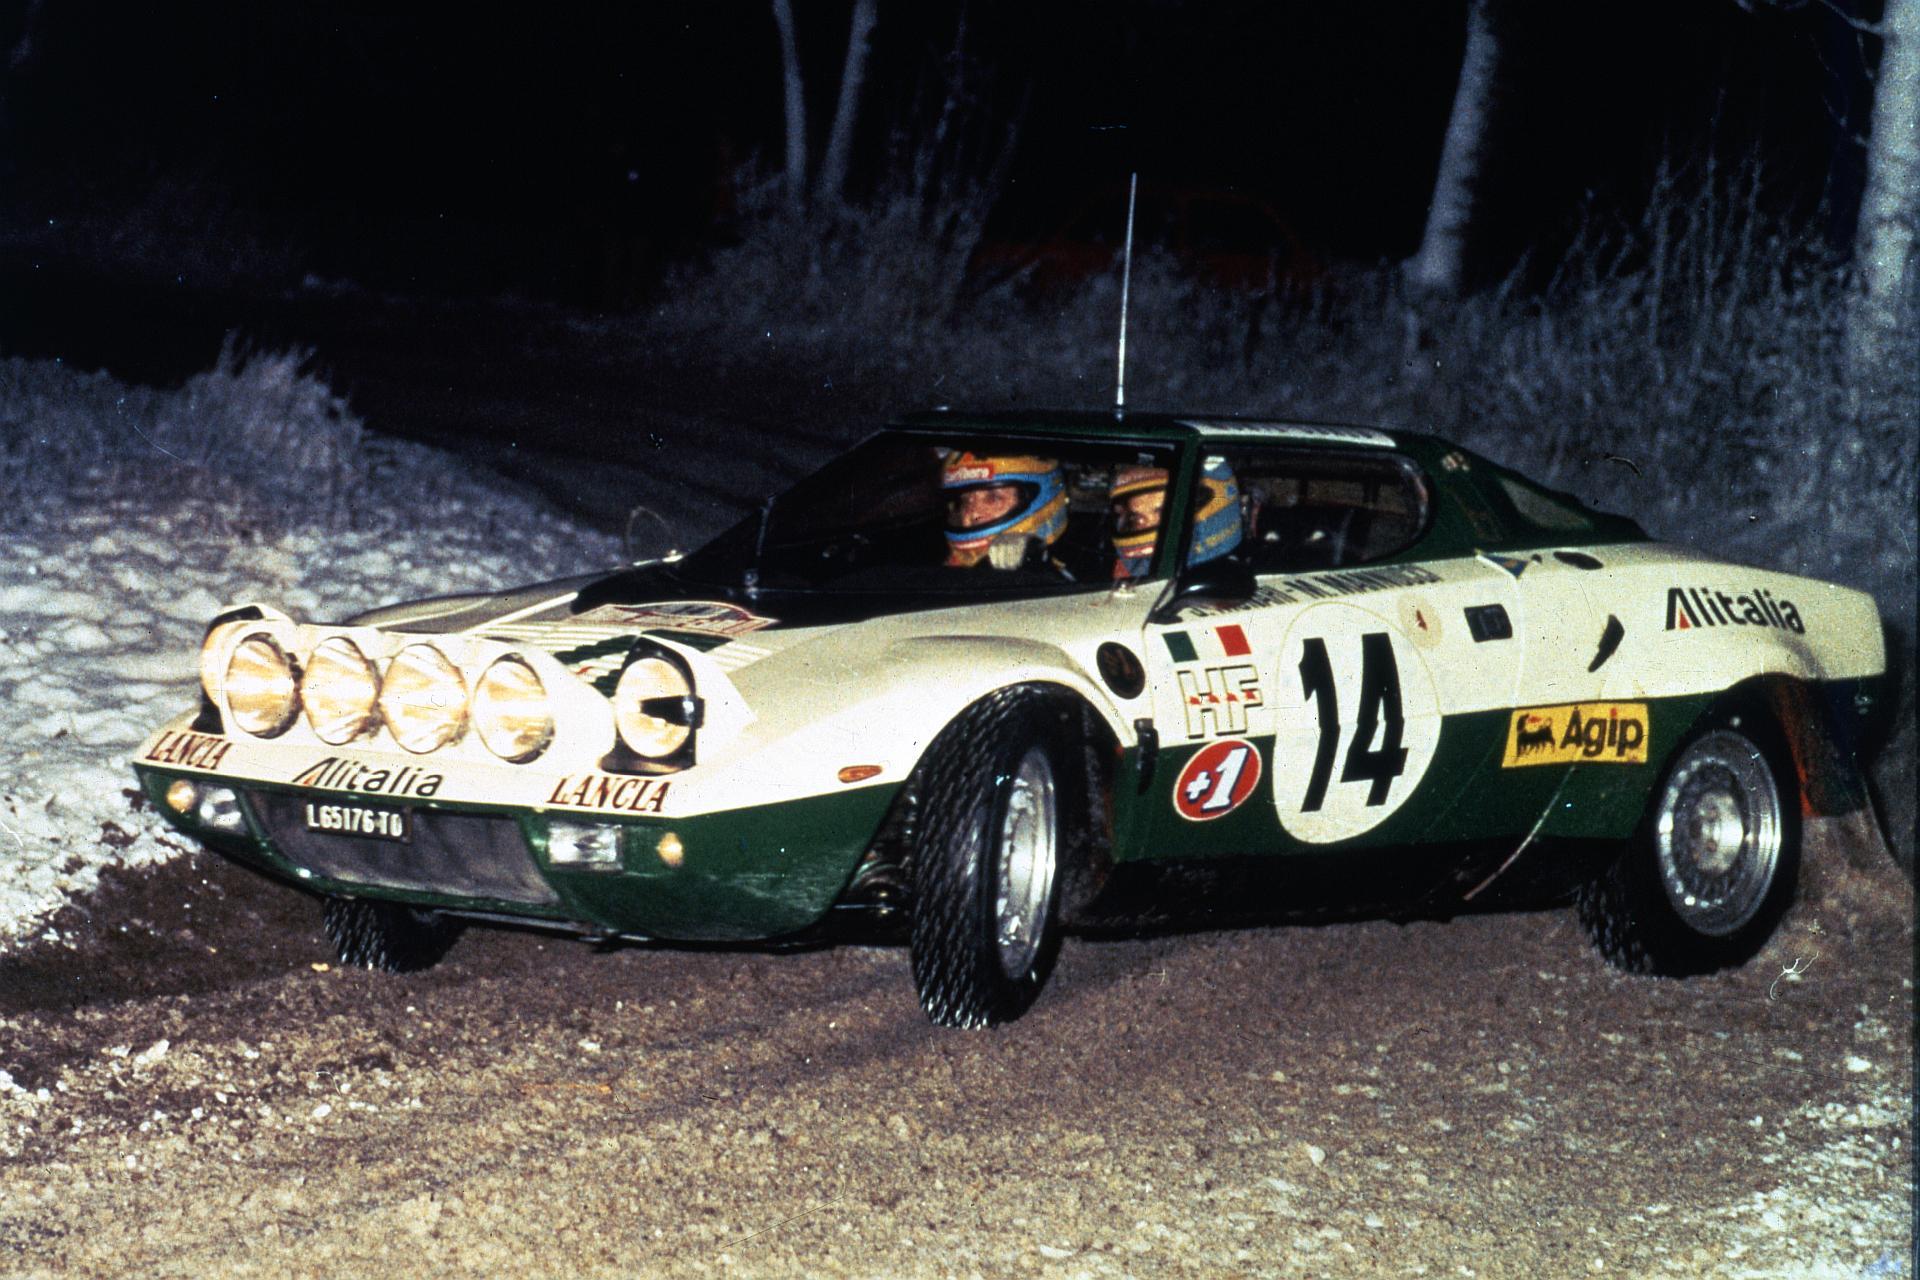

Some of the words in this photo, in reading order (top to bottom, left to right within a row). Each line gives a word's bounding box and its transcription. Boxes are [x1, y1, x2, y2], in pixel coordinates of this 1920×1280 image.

[1665, 587, 1806, 634] Alitalia
[1298, 632, 1408, 813] 14
[1559, 705, 1644, 758] Agip
[145, 731, 233, 770] LANCIA
[292, 757, 445, 797] Alitalia
[546, 774, 673, 813] LANCIA
